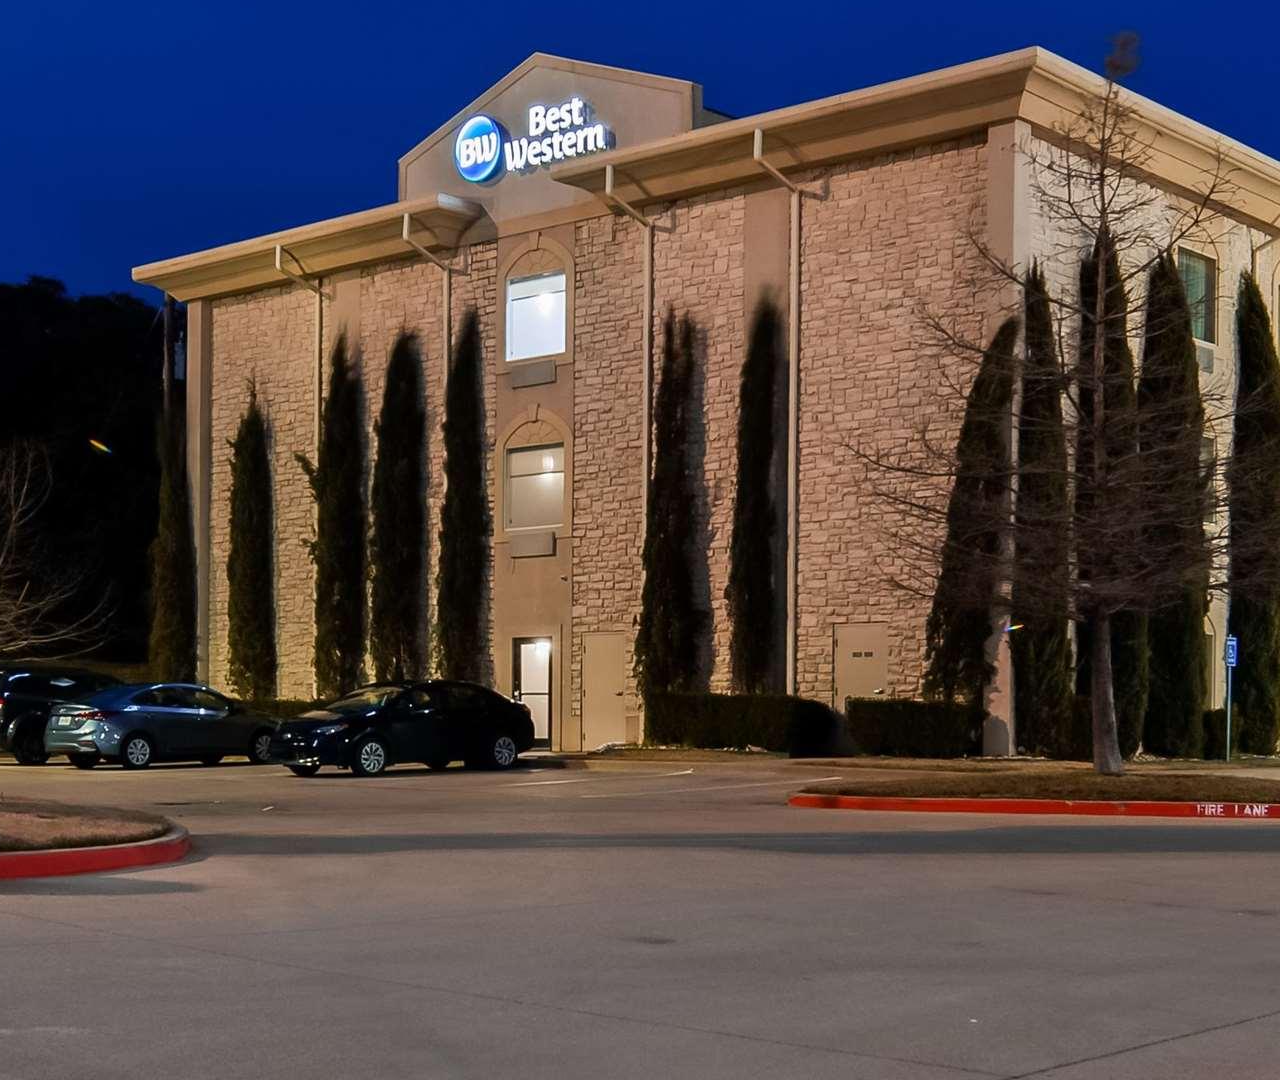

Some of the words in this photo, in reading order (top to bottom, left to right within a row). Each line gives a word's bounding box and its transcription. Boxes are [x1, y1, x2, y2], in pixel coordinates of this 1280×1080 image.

[528, 96, 584, 137] Best
[458, 132, 498, 169] BW
[503, 123, 608, 172] Western
[1197, 804, 1225, 817] FIRE
